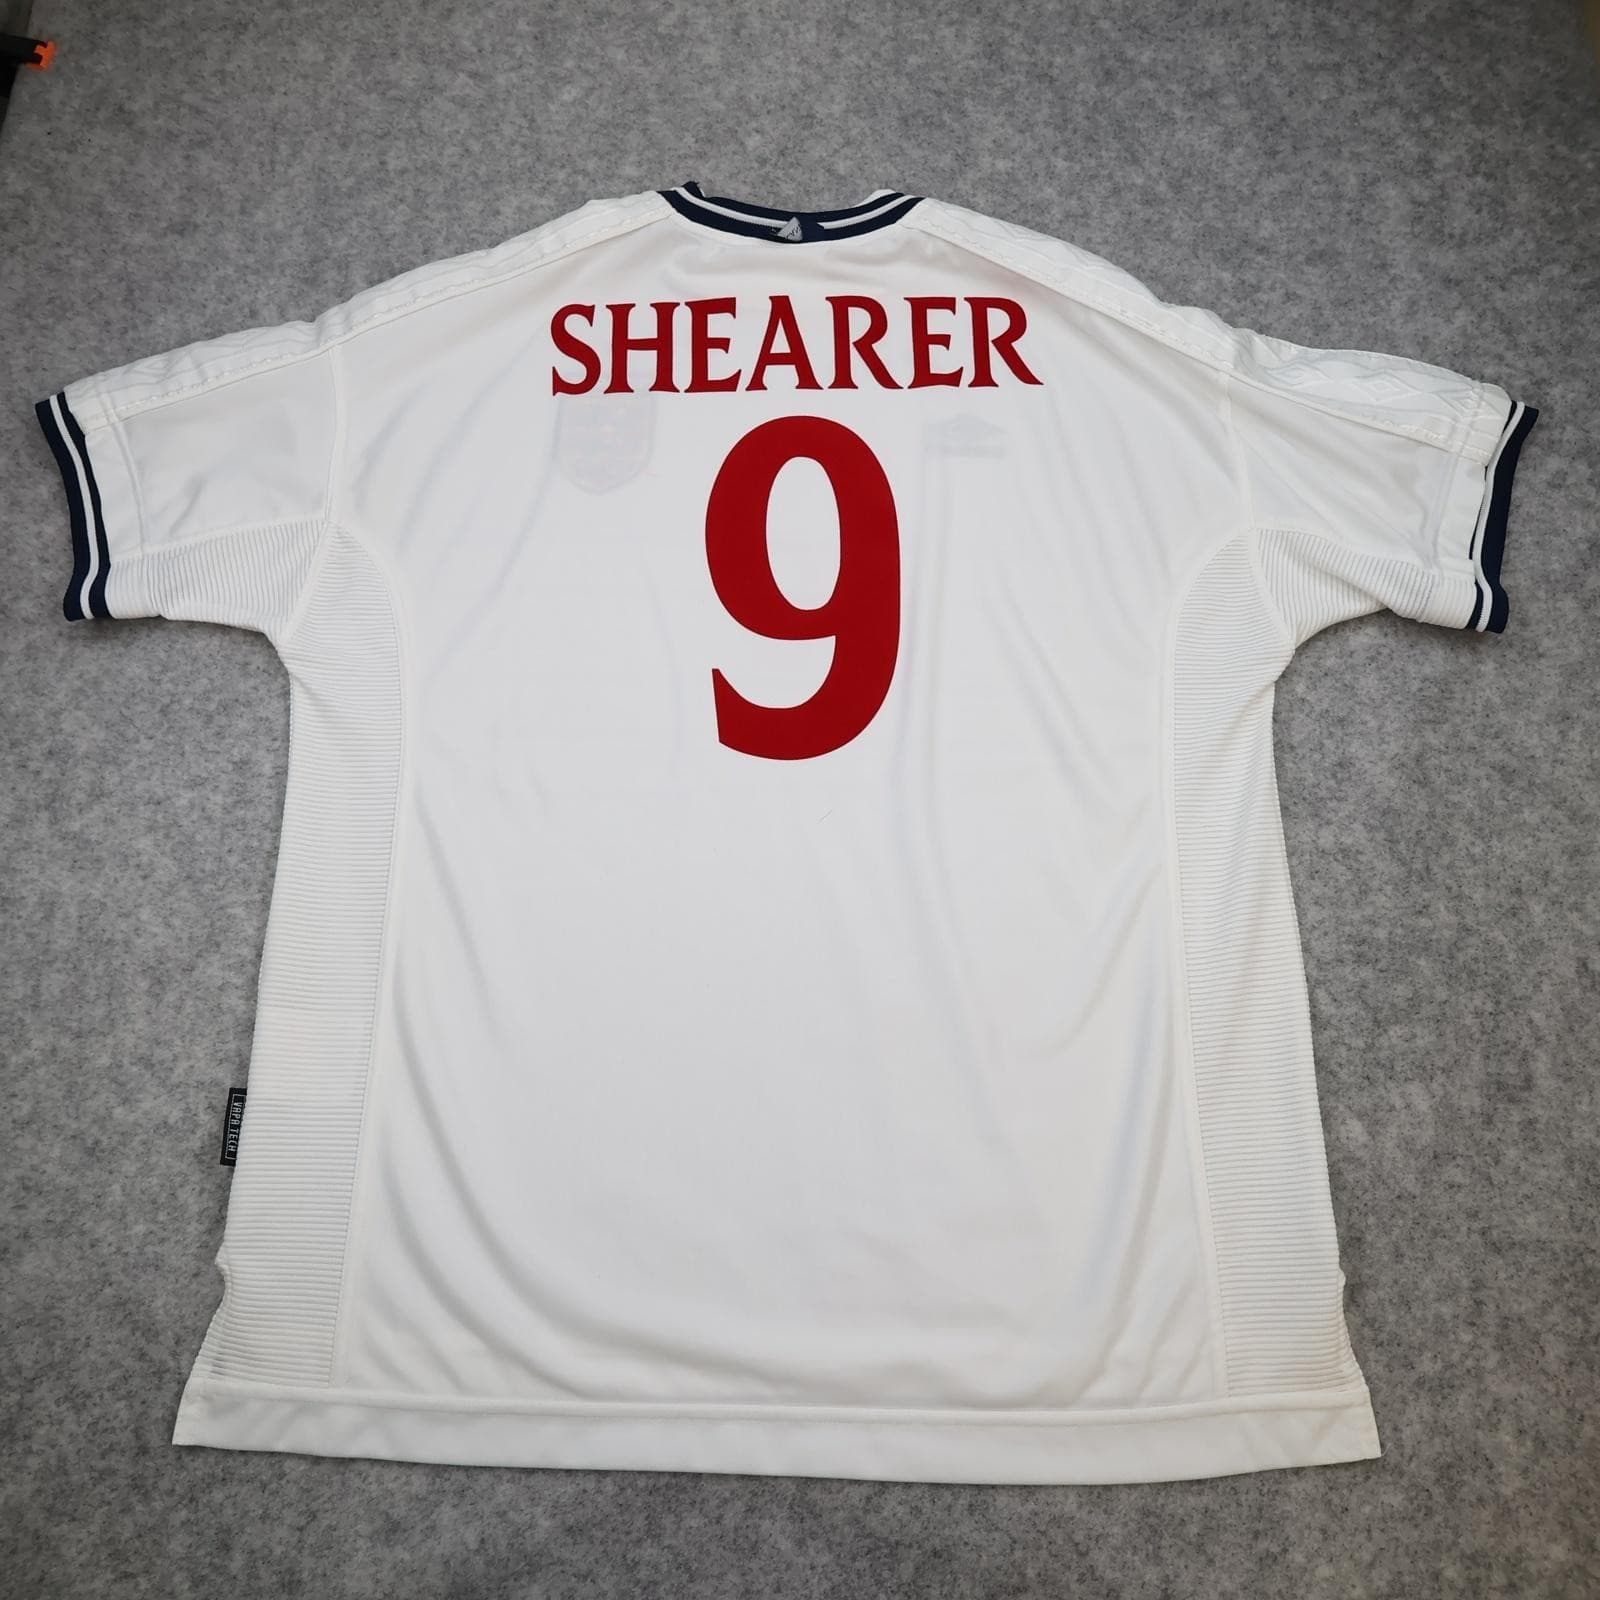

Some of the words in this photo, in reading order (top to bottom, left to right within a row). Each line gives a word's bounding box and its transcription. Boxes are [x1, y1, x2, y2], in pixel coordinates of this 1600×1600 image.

[551, 295, 1044, 396] SHEARER
[706, 415, 901, 761] 9
[228, 1128, 240, 1152] TECH
[230, 1102, 243, 1125] VAPA
